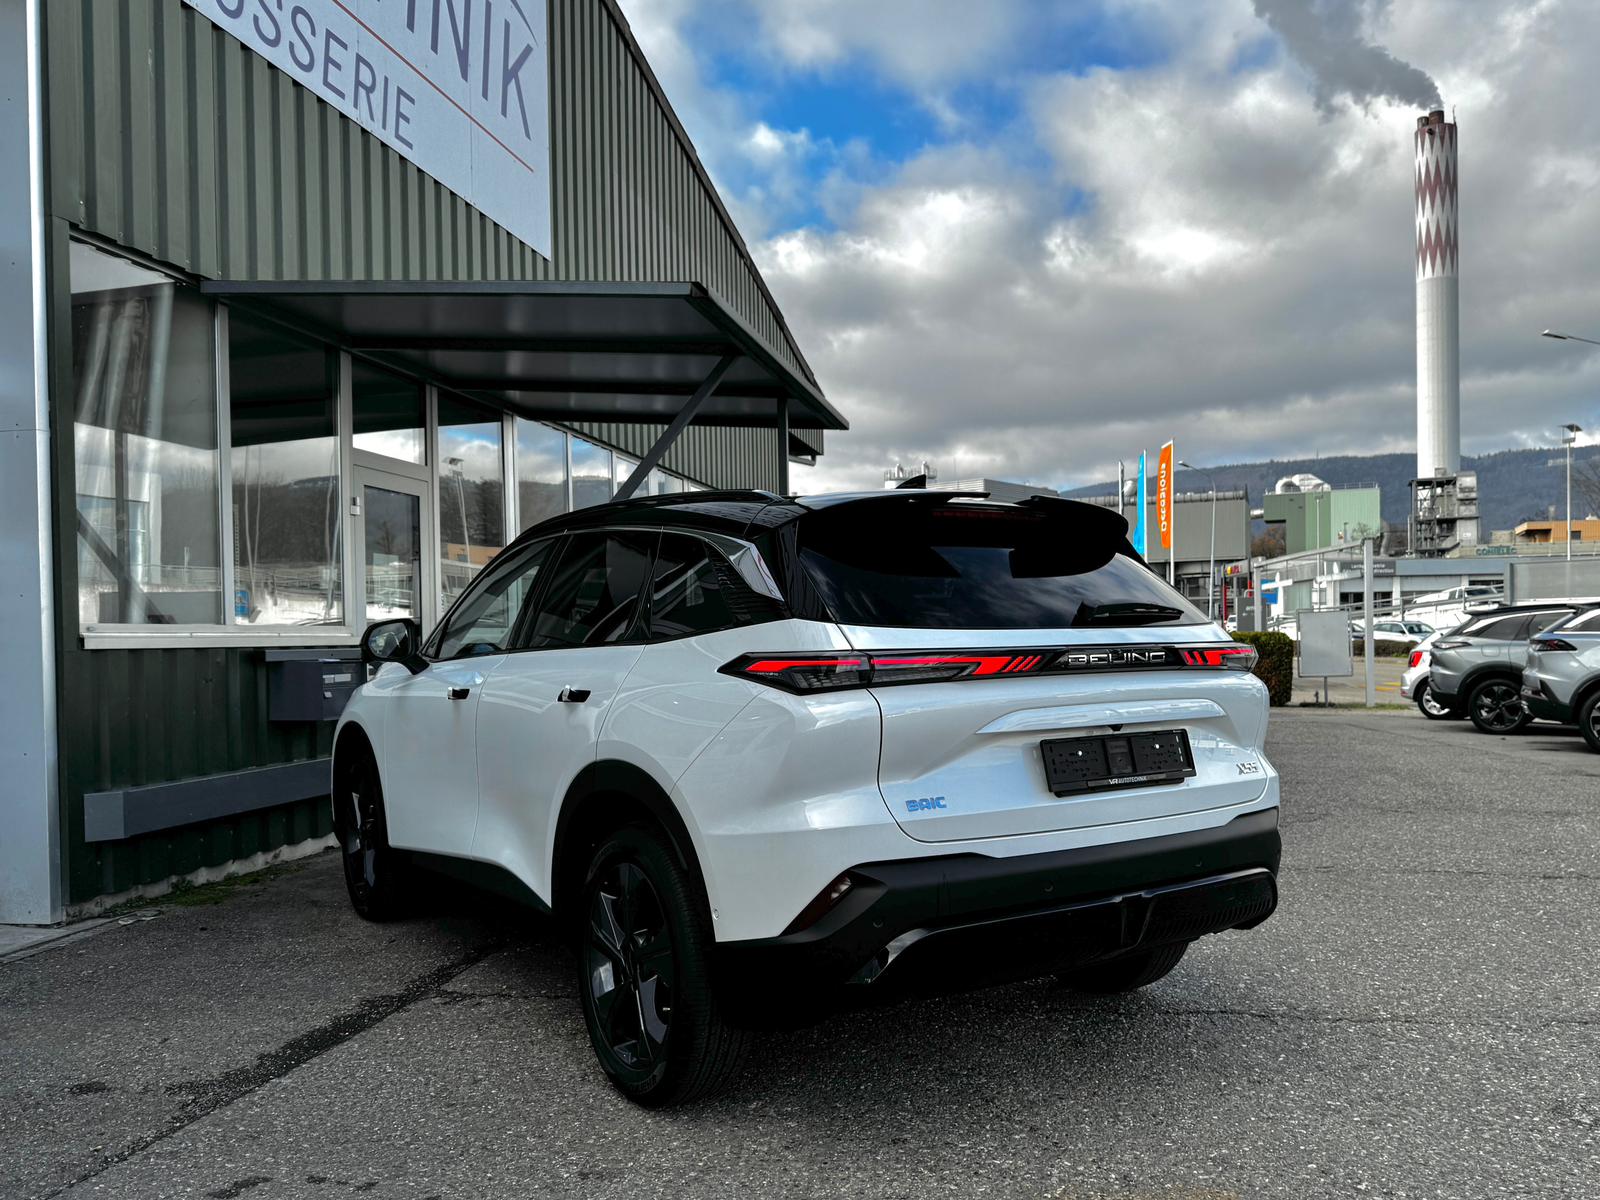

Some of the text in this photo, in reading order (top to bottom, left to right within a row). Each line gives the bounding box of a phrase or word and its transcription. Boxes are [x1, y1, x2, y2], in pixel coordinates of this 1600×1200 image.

[1068, 651, 1166, 665] BEIJING
[1236, 762, 1260, 775] X55
[905, 796, 947, 812] BAIC
